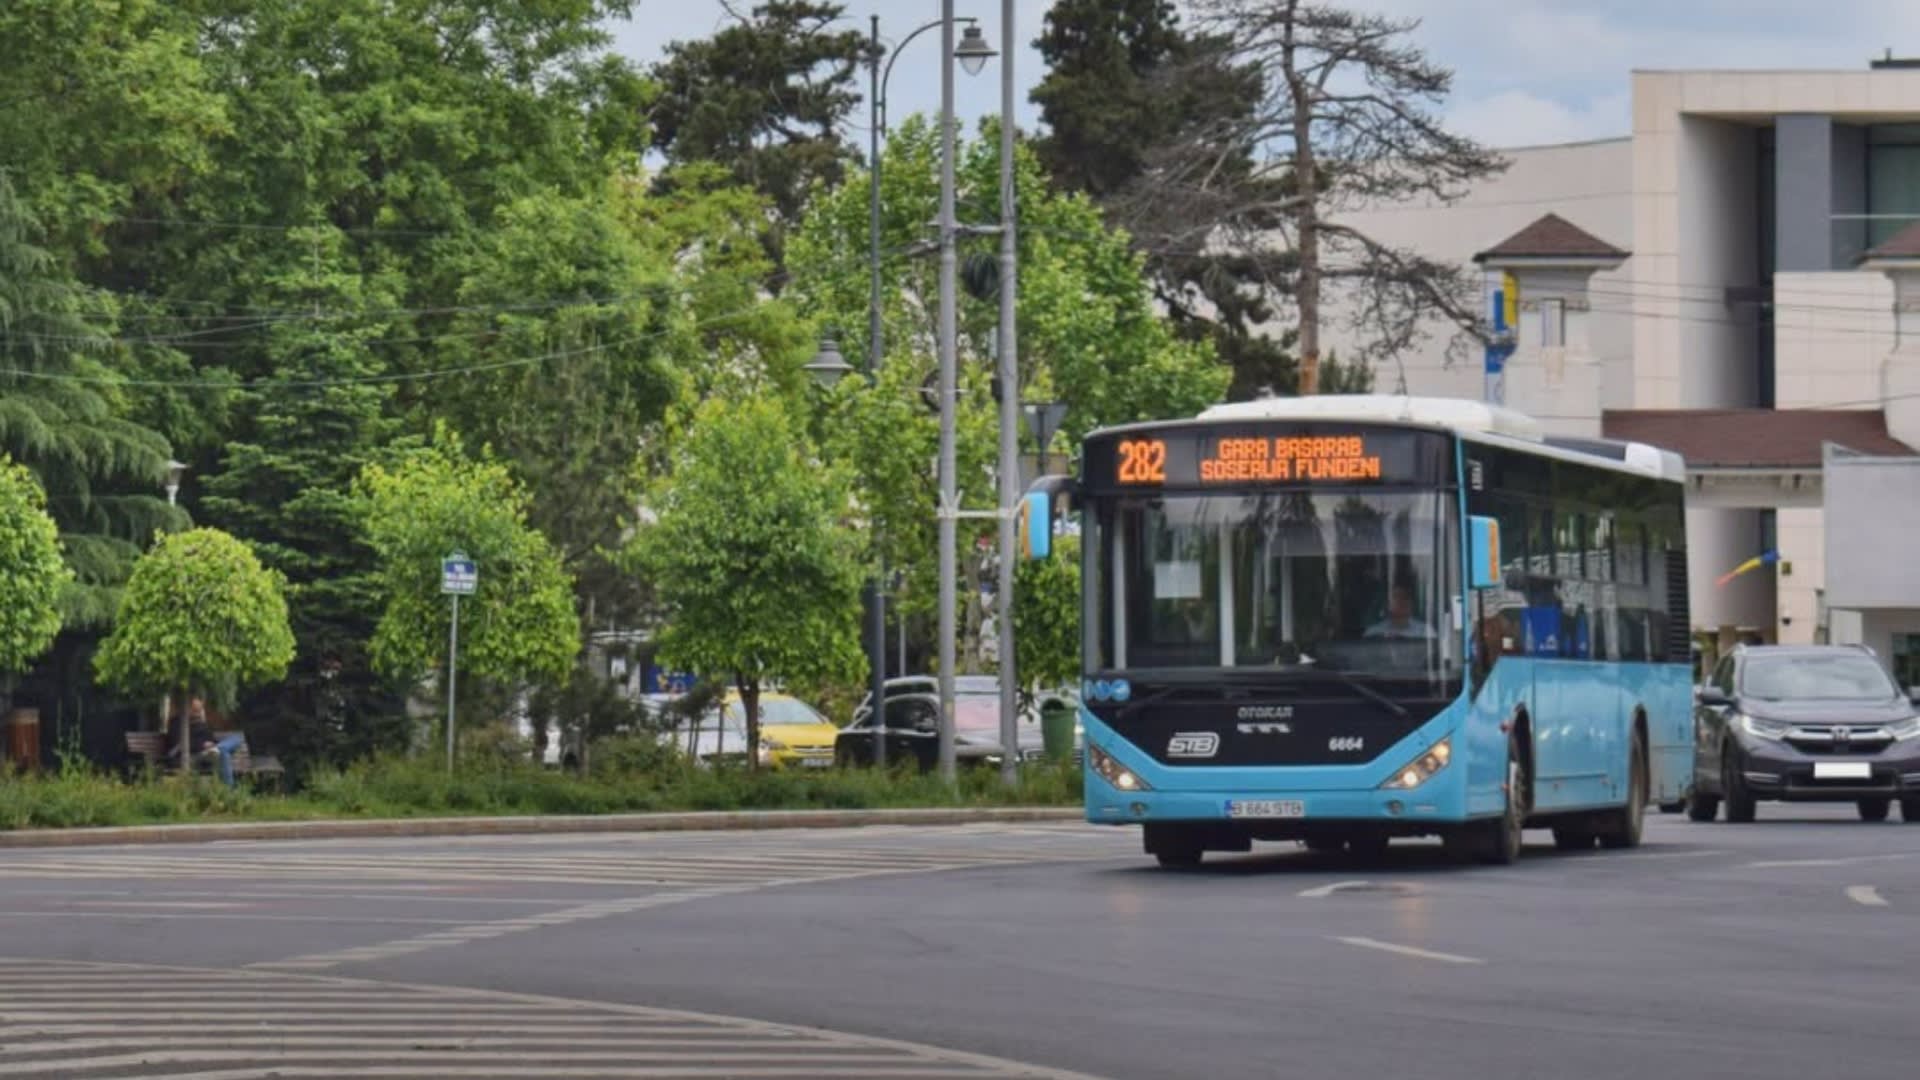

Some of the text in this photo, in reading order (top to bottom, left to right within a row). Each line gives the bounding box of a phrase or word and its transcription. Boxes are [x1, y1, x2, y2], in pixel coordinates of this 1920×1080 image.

[1219, 436, 1362, 459] GARA BASARAB
[1119, 440, 1166, 482] 282
[1296, 457, 1380, 479] FUNDENI
[1167, 736, 1216, 755] STB
[1329, 736, 1363, 751] 6664
